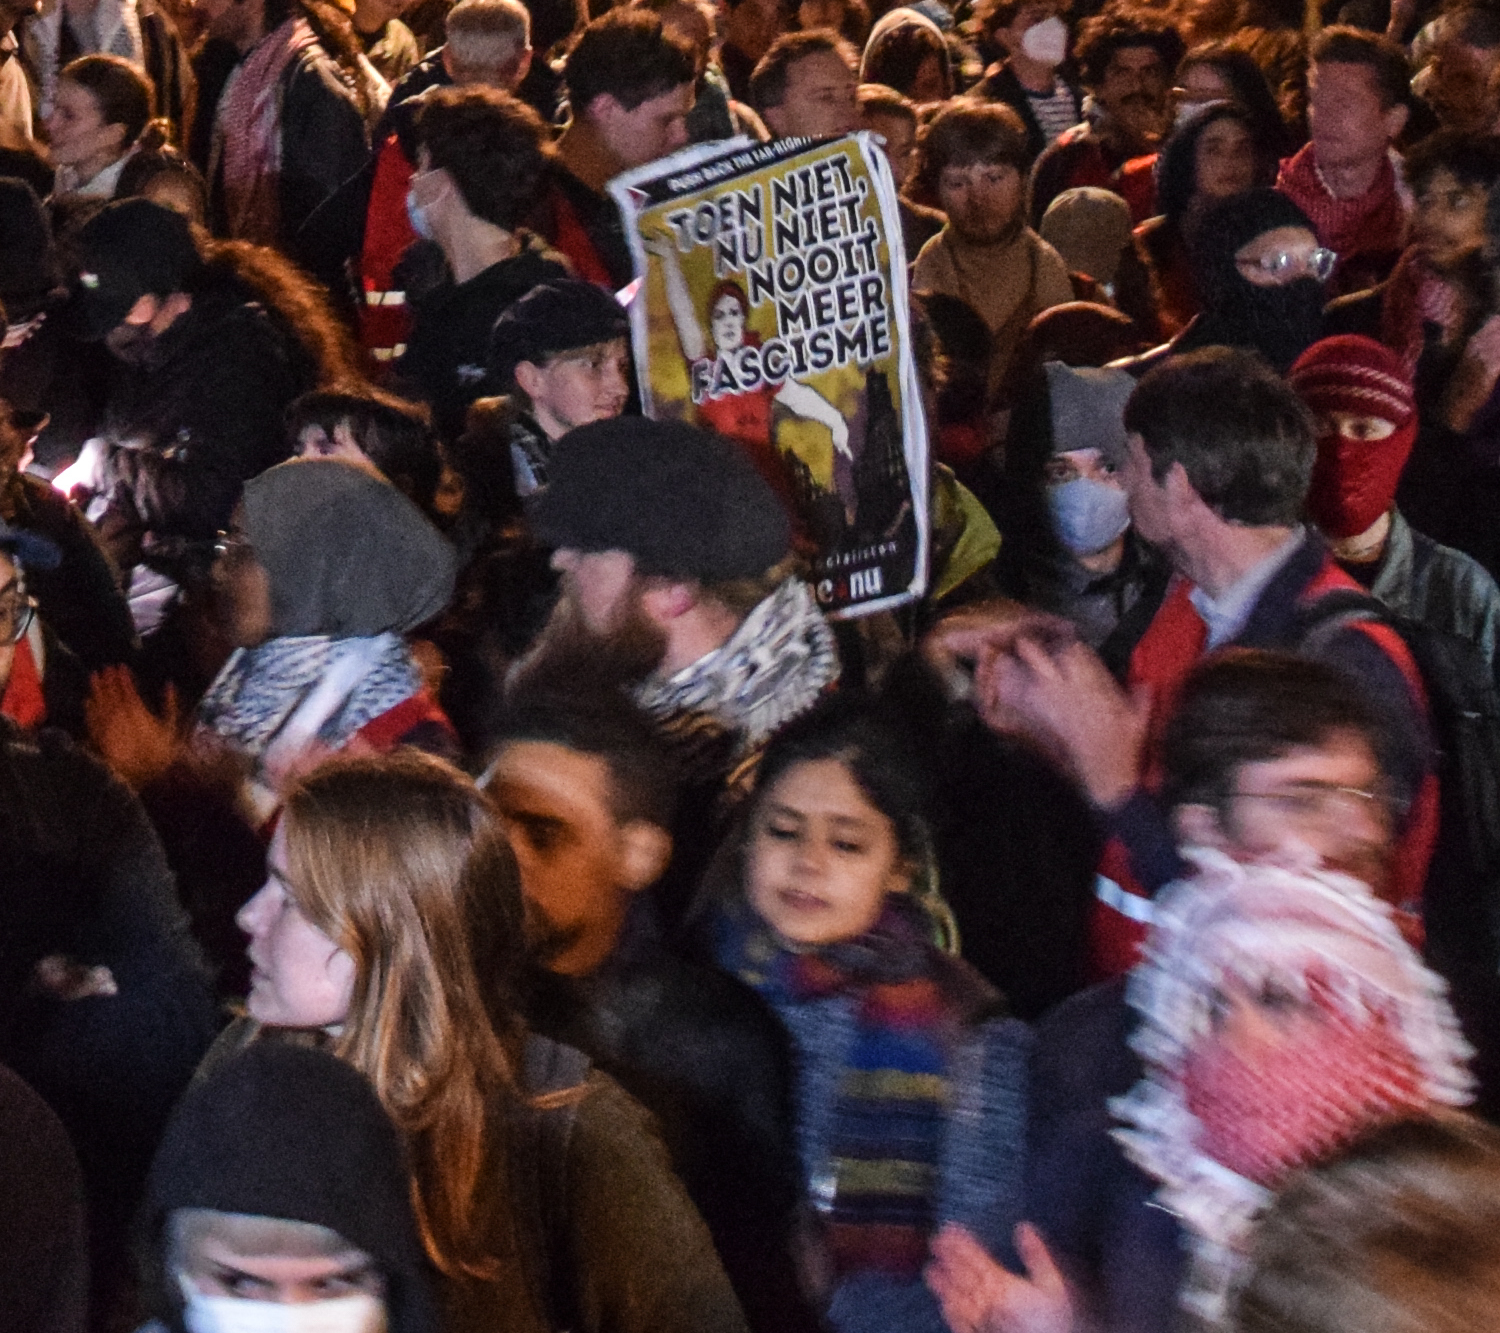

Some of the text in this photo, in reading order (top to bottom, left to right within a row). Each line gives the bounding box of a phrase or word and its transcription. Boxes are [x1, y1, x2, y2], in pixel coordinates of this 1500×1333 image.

[666, 155, 867, 252] TOEN NIET,
[717, 194, 876, 277] NU NIET,
[750, 232, 879, 305] NOOIT
[778, 276, 886, 336] MEER
[692, 317, 891, 402] FASCISME
